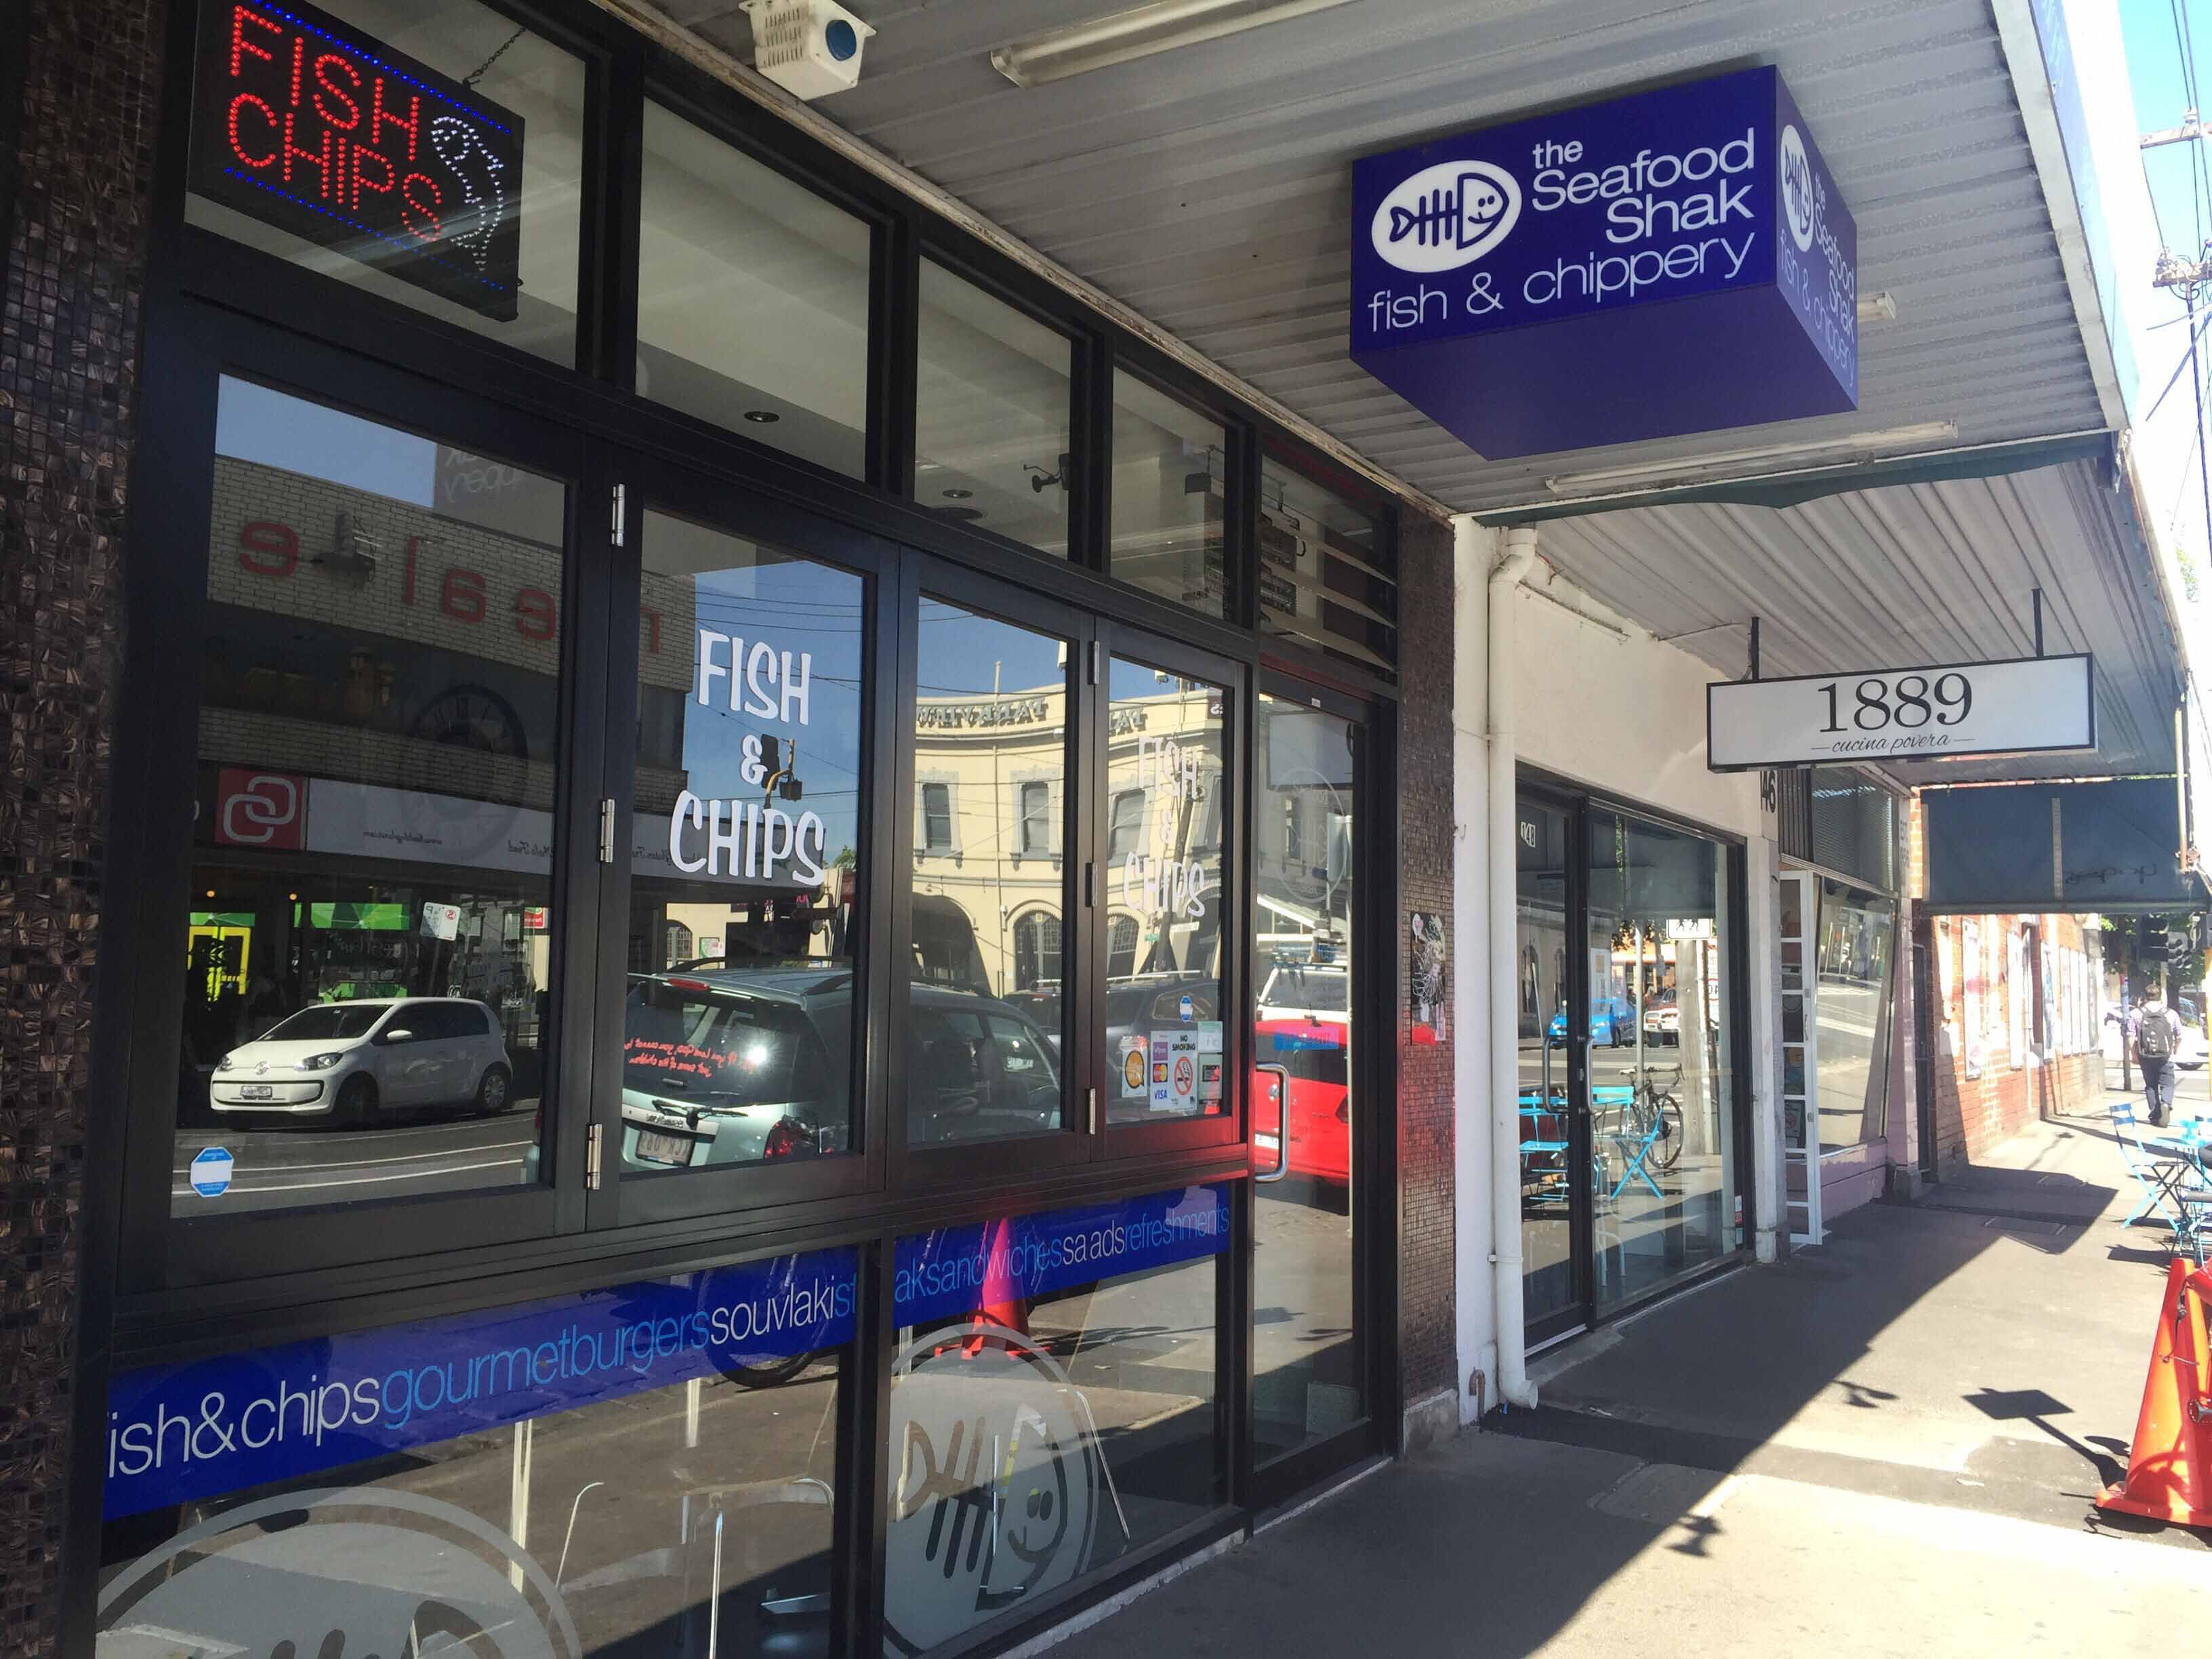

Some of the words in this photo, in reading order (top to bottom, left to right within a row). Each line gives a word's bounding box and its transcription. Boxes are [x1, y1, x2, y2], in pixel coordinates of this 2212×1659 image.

[231, 5, 420, 161] FISH
[228, 93, 443, 242] CHIPS
[1532, 140, 1583, 169] the
[1532, 127, 1755, 212] Seafood
[1815, 173, 1826, 211] the
[1606, 180, 1756, 244] Shak
[1368, 283, 1448, 333] fish
[1467, 272, 1504, 315] &
[1523, 232, 1756, 303] chippery
[1815, 205, 1855, 302] Seafood
[1780, 228, 1799, 295] fish
[1803, 268, 1811, 315] &
[1813, 297, 1855, 387] chippery
[1828, 269, 1855, 344] Shak
[697, 628, 811, 725] FISH
[1818, 673, 1972, 733] 1889
[741, 734, 768, 784] &
[1138, 736, 1198, 800] FISH
[1832, 737, 1887, 752] cucina
[1889, 734, 1950, 754] povera
[670, 790, 825, 886] CHIPS
[1124, 851, 1205, 917] CHIPS
[1154, 1089, 1167, 1100] VISA
[108, 1374, 380, 1478] ish&chips
[711, 1275, 835, 1346] souvlaki
[1124, 1204, 1229, 1252] refreshments
